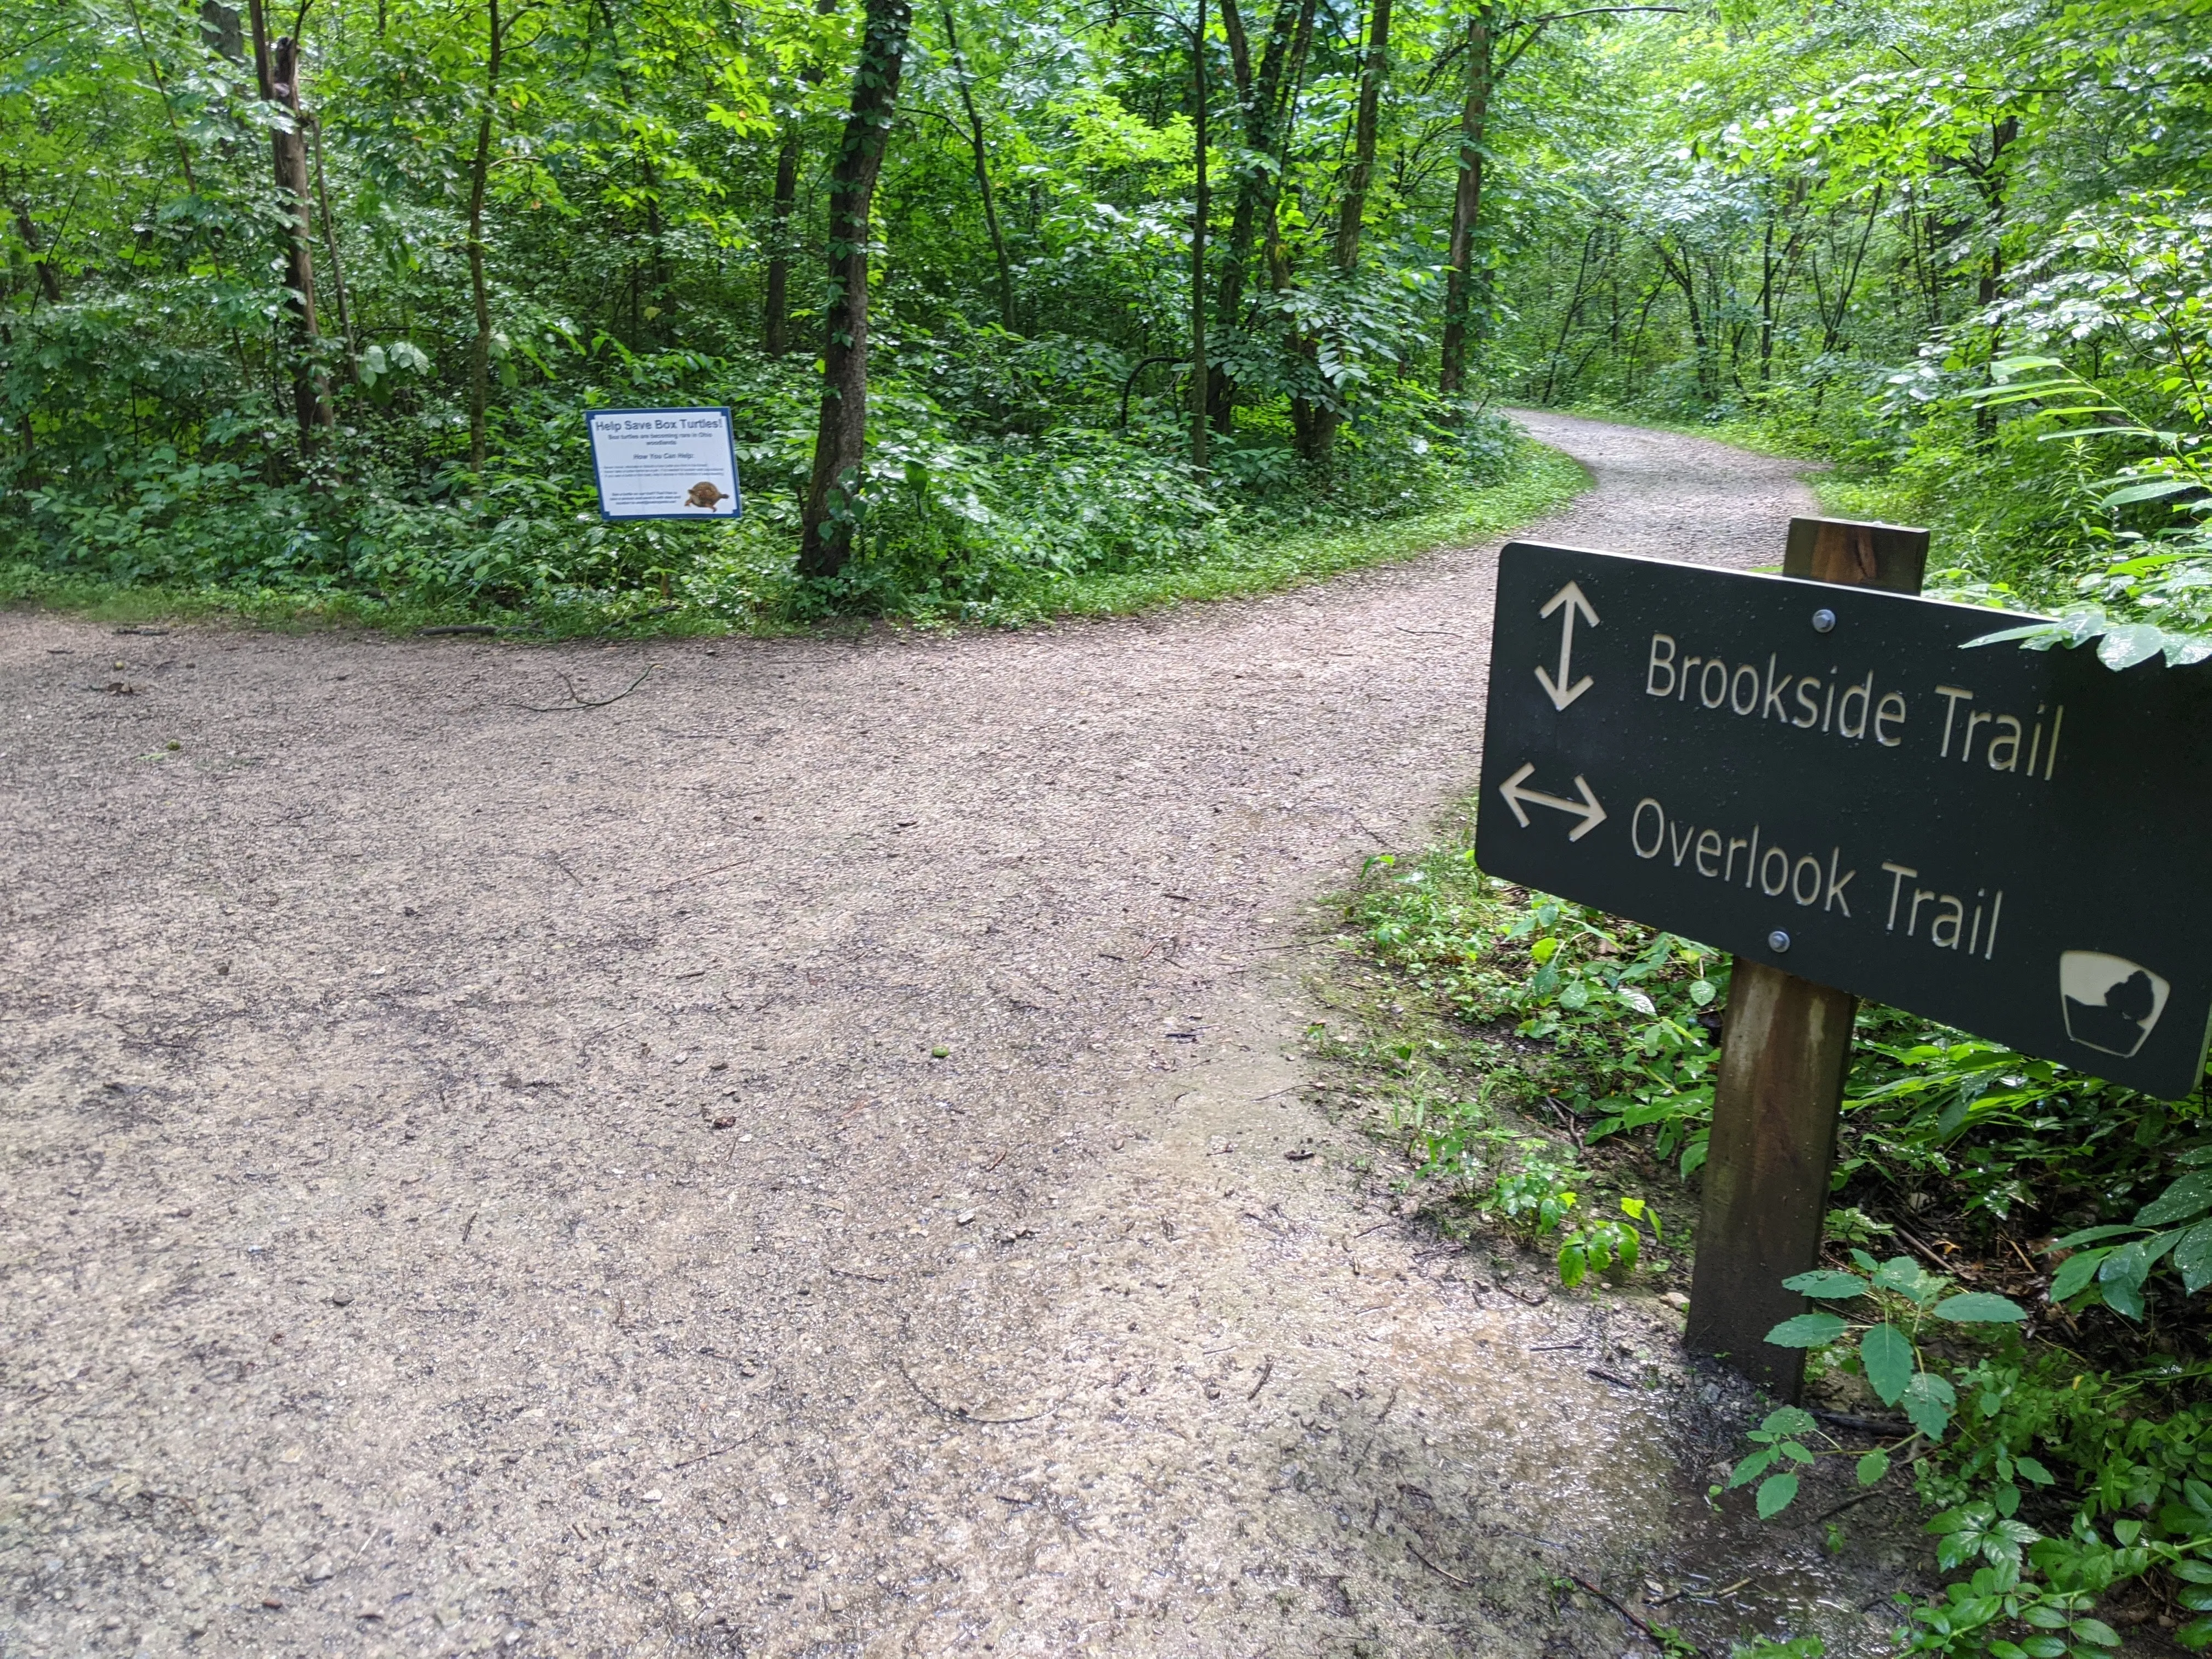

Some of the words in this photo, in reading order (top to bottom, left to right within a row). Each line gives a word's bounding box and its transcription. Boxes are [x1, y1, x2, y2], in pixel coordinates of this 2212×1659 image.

[596, 421, 621, 432] Help
[624, 420, 652, 430] Save
[655, 420, 678, 429] Box
[680, 419, 723, 428] Turtles!
[1645, 633, 1907, 748] Brookside
[1934, 684, 2064, 781] Trail
[1631, 797, 1857, 918] Overlook
[1882, 861, 2004, 961] Trail
